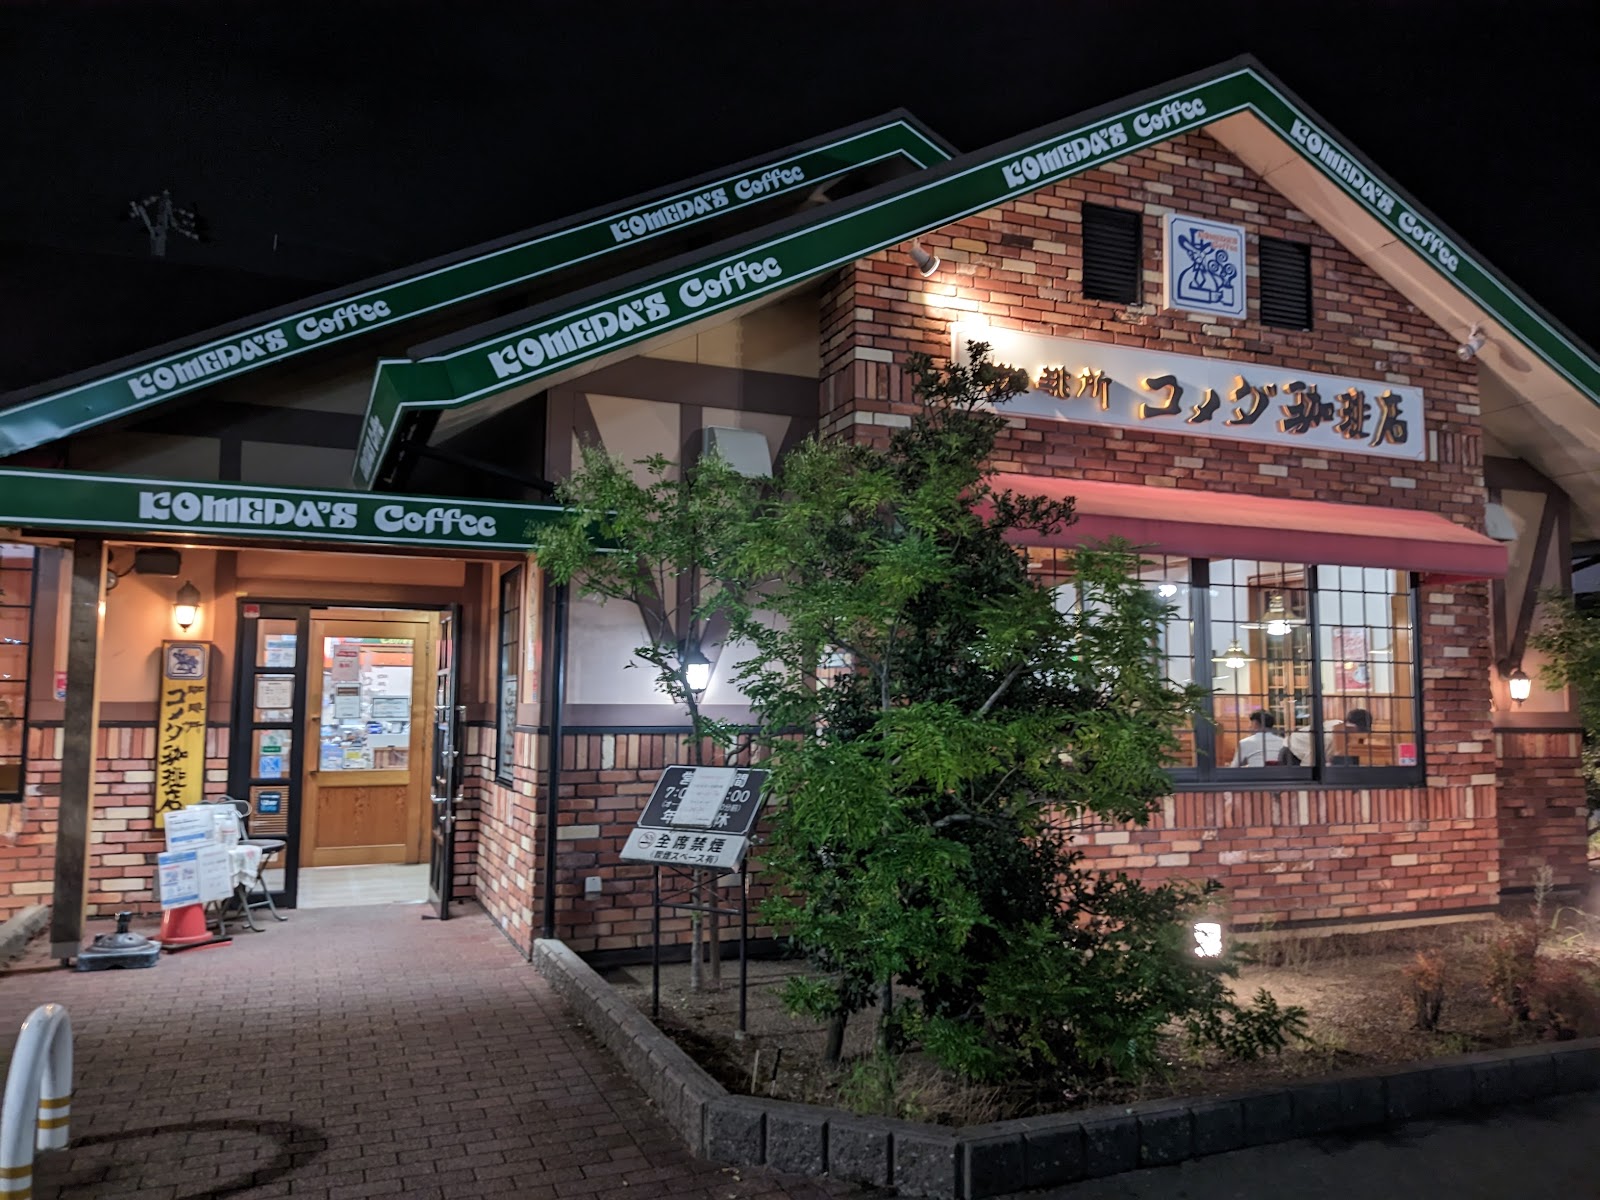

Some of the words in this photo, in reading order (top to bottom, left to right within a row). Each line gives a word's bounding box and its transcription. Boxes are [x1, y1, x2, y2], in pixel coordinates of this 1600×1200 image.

[1001, 122, 1128, 189] KOMEDA'S
[1132, 97, 1207, 137] Coffee
[609, 187, 729, 242] KOMEDA'S
[734, 165, 805, 200] Coffee
[1290, 118, 1395, 216] KOMEDA'S
[1398, 211, 1459, 272] Coffee
[127, 328, 289, 400] KOMEDA'S
[296, 300, 391, 340] Coffee
[487, 291, 671, 379] KOMEDA'S
[678, 256, 782, 308] Coffee
[1138, 373, 1409, 447] コメダ珈琲店
[139, 491, 358, 529] KOMEDA'S
[373, 504, 497, 537] Coffee
[654, 833, 727, 853] 全席禁煙
